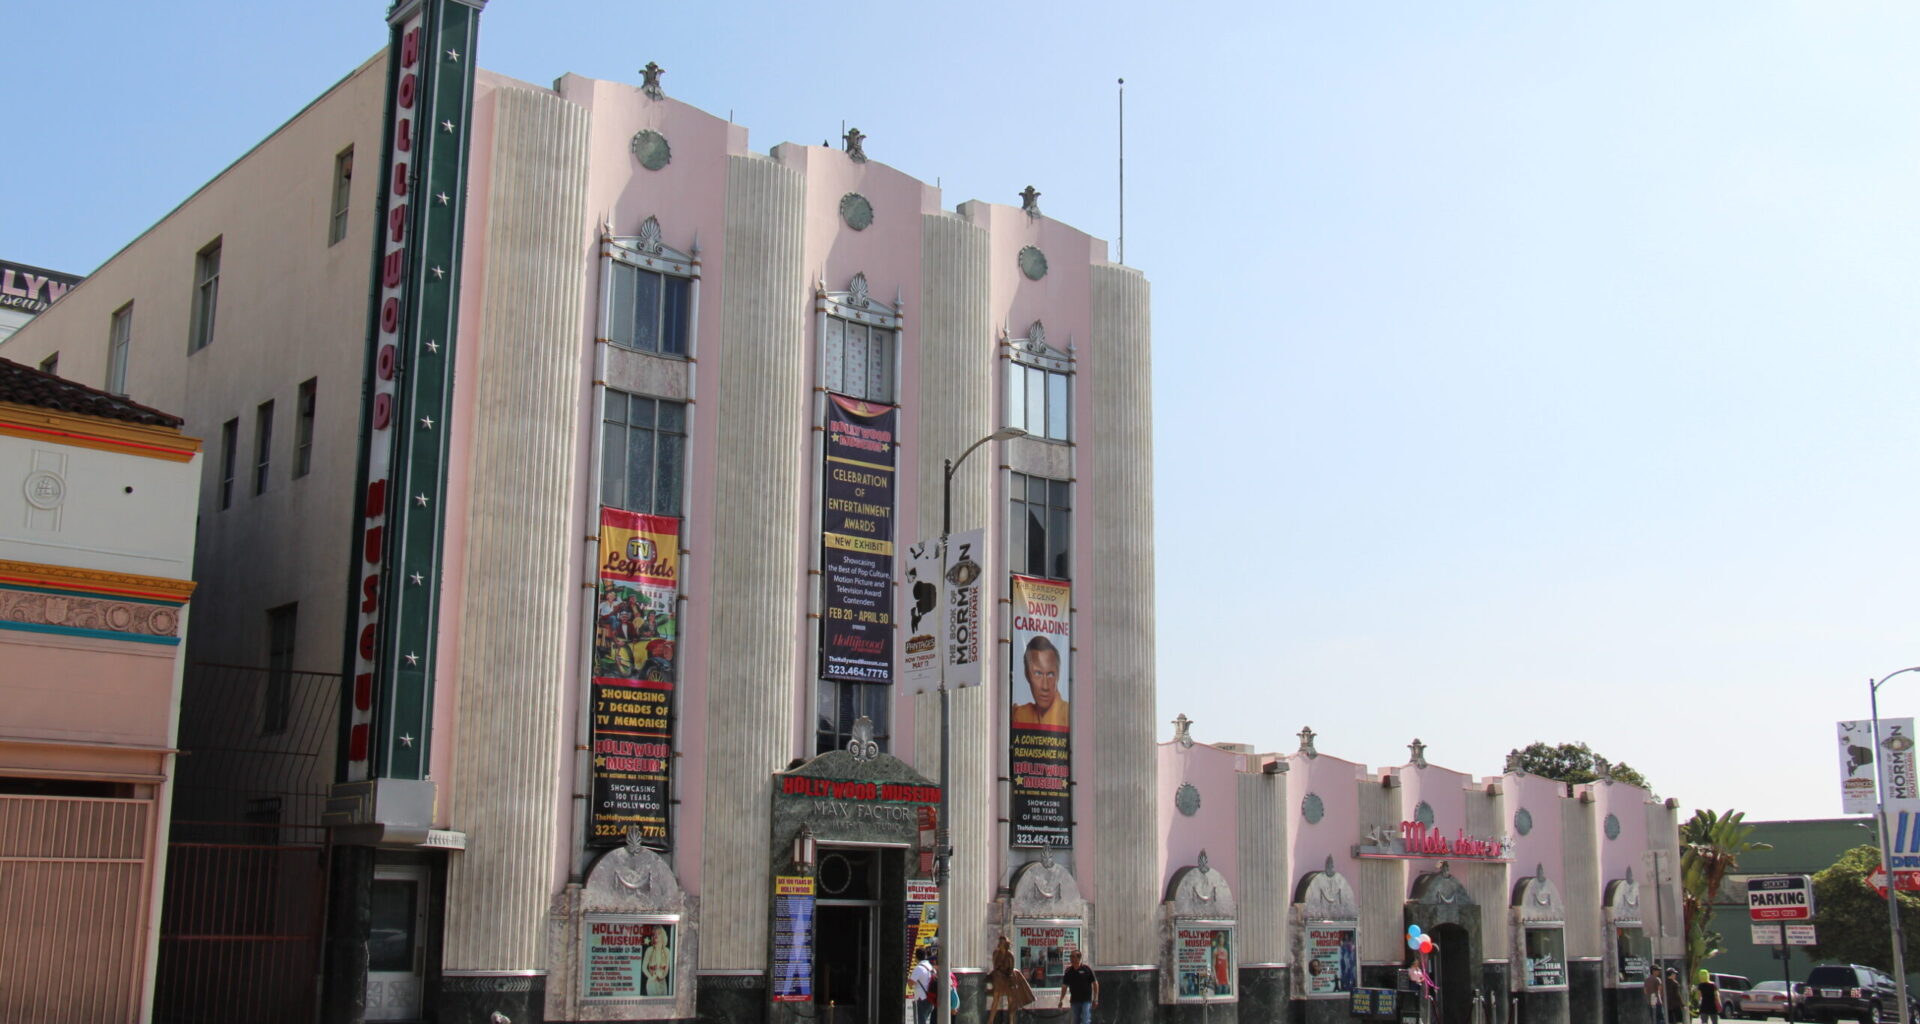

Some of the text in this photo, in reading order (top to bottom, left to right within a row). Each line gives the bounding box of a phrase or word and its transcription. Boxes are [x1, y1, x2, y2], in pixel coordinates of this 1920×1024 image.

[373, 26, 422, 430] HOLLYWOOD
[830, 420, 891, 442] HOLLYWOOD
[833, 468, 888, 488] CELEBRATION
[854, 488, 865, 497] OF
[828, 498, 891, 518] ENTERTAINMENT
[844, 517, 876, 532] AWARDS
[630, 540, 650, 559] TV
[834, 536, 884, 552] NEW EXHIBIT
[603, 551, 674, 578] Legends
[843, 555, 876, 568] Showcasing
[828, 564, 838, 572] the
[838, 565, 850, 574] Best
[858, 568, 868, 576] Pop
[834, 574, 854, 584] Motion
[854, 578, 874, 587] Picture
[836, 584, 882, 598] Television Award
[950, 590, 957, 604] OF
[1028, 593, 1057, 602] LEGEND
[843, 596, 876, 606] Contenders
[829, 607, 842, 619] FEB
[844, 608, 853, 620] 20
[858, 610, 878, 623] APRIL
[879, 612, 889, 624] 30
[1028, 600, 1058, 618] DAVID
[1014, 616, 1070, 636] CARRADINE
[828, 664, 889, 679] 323.464.7776
[601, 688, 666, 702] SHOWCASING
[598, 702, 669, 716] 7 DECADES OF
[596, 714, 668, 728] TV MEMORIES!
[1014, 734, 1020, 745] A
[595, 738, 670, 758] HOLLYWOOD
[1014, 747, 1057, 760] RENAISSANCE
[606, 756, 661, 772] MUSEUM
[1014, 760, 1069, 778] HOLLYWOOD
[610, 784, 656, 792] SHOWCASING
[783, 776, 943, 804] HOLLYWOOD MUSEUM
[615, 792, 651, 801] 100 YEARS
[616, 802, 660, 810] HOLLYWOOD
[814, 800, 911, 822] MAX FACTOR
[1027, 800, 1060, 808] SHOWCASING
[1031, 806, 1040, 814] 100
[1032, 814, 1064, 822] HOLLYWOOD
[595, 824, 666, 838] 323.4.7776
[1401, 820, 1450, 856] Mels
[1016, 833, 1070, 845] 323.464.7776
[1890, 856, 1920, 868] DR
[1750, 892, 1805, 906] PARKING
[592, 923, 654, 936] HOLLYWOOD
[1020, 927, 1064, 938] HOLLYWOOD
[601, 936, 644, 946] MUSEUM
[1028, 937, 1058, 946] MUSEUM
[1184, 939, 1212, 948] MUSEUM
[592, 946, 606, 954] Come
[608, 946, 624, 954] Inside
